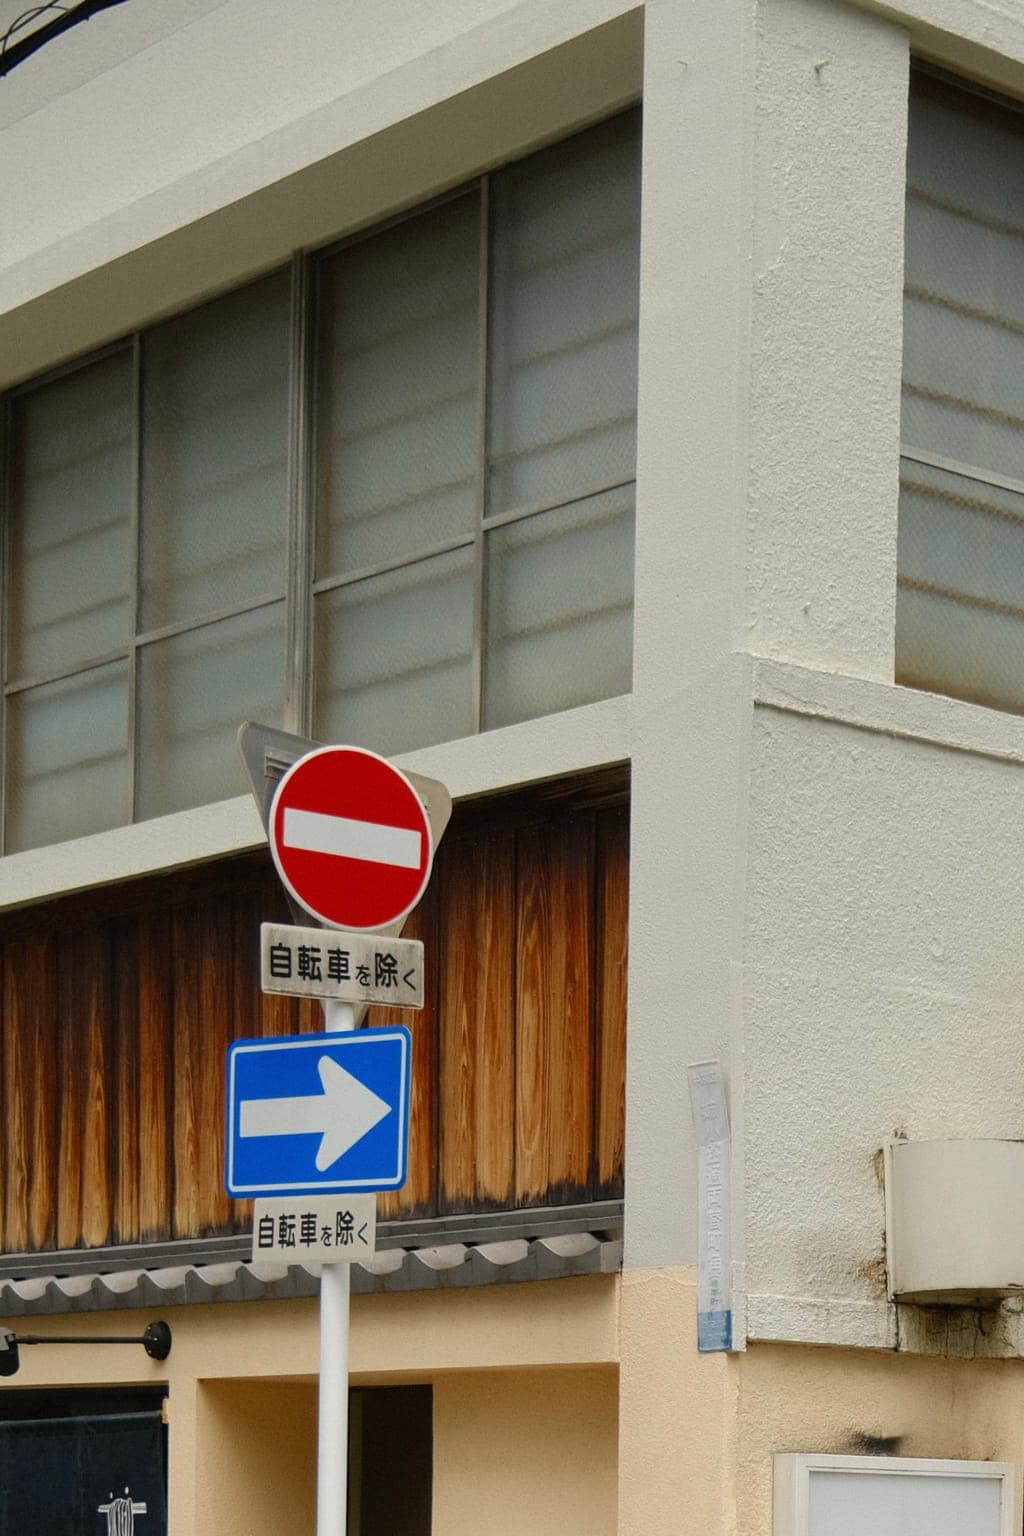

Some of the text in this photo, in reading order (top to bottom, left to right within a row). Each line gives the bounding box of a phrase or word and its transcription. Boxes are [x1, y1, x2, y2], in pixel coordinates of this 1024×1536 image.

[269, 941, 416, 991] 自転車を除く
[257, 1210, 368, 1249] 自転車を除く
